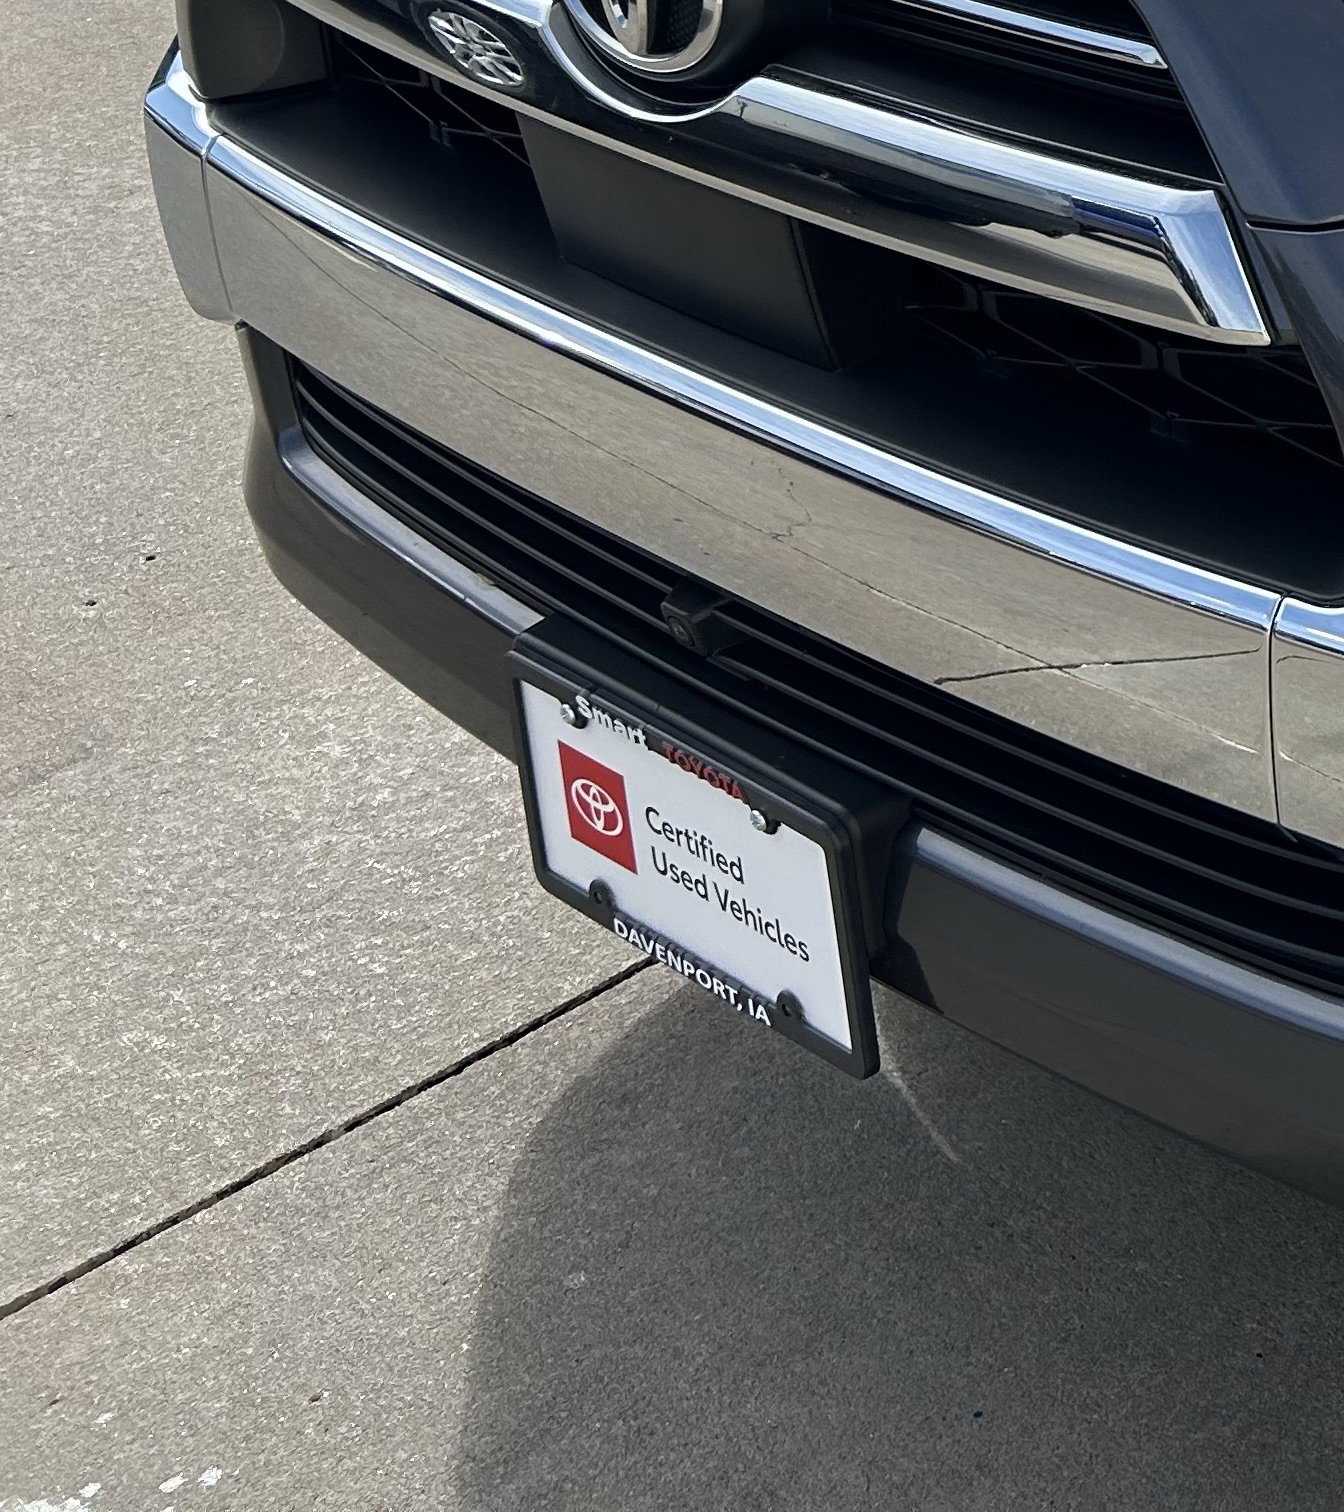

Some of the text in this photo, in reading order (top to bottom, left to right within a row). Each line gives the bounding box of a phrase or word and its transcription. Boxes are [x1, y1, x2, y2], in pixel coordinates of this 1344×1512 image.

[575, 694, 746, 800] Smart TOYOTA
[645, 806, 744, 885] Certified
[650, 845, 810, 963] Used Vehicles
[613, 917, 772, 1027] DAVENPORT, IA
